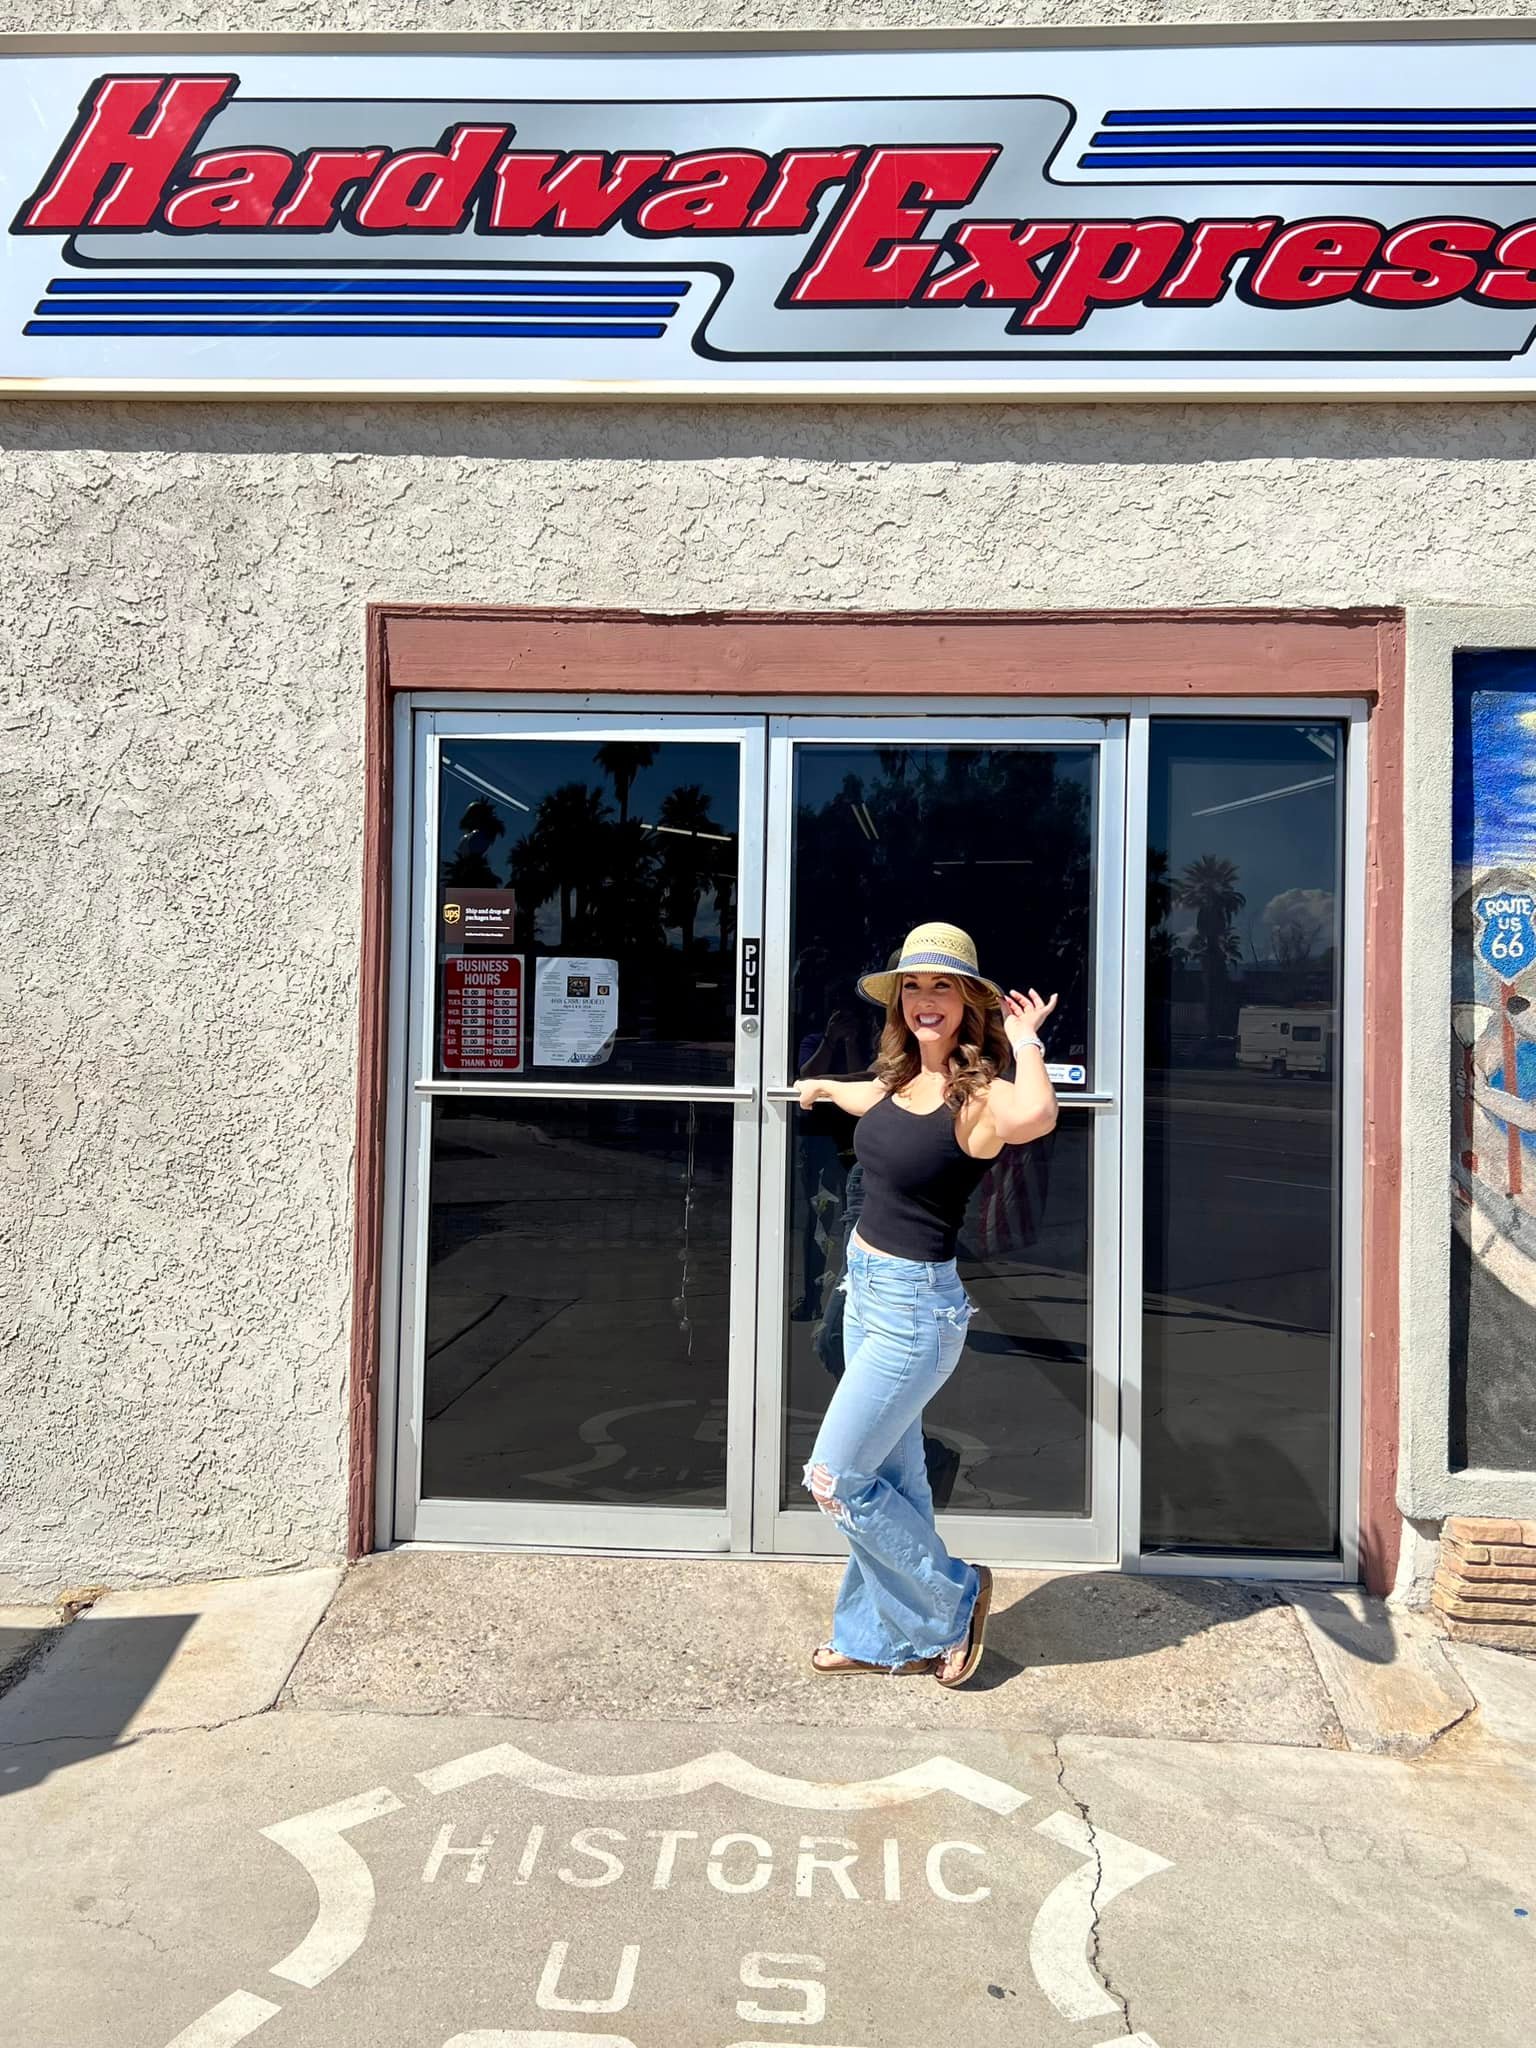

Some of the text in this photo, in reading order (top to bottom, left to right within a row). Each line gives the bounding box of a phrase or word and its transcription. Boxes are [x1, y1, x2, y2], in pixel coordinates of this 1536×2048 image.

[1484, 899, 1531, 917] ROUTE
[1498, 916, 1522, 932] US
[1491, 932, 1524, 959] 66
[456, 959, 510, 972] BUSINESS
[464, 973, 501, 985] HOURS
[745, 944, 757, 1009] PULL
[460, 1059, 504, 1067] THANK YOU
[420, 1820, 994, 1903] HISTORIC
